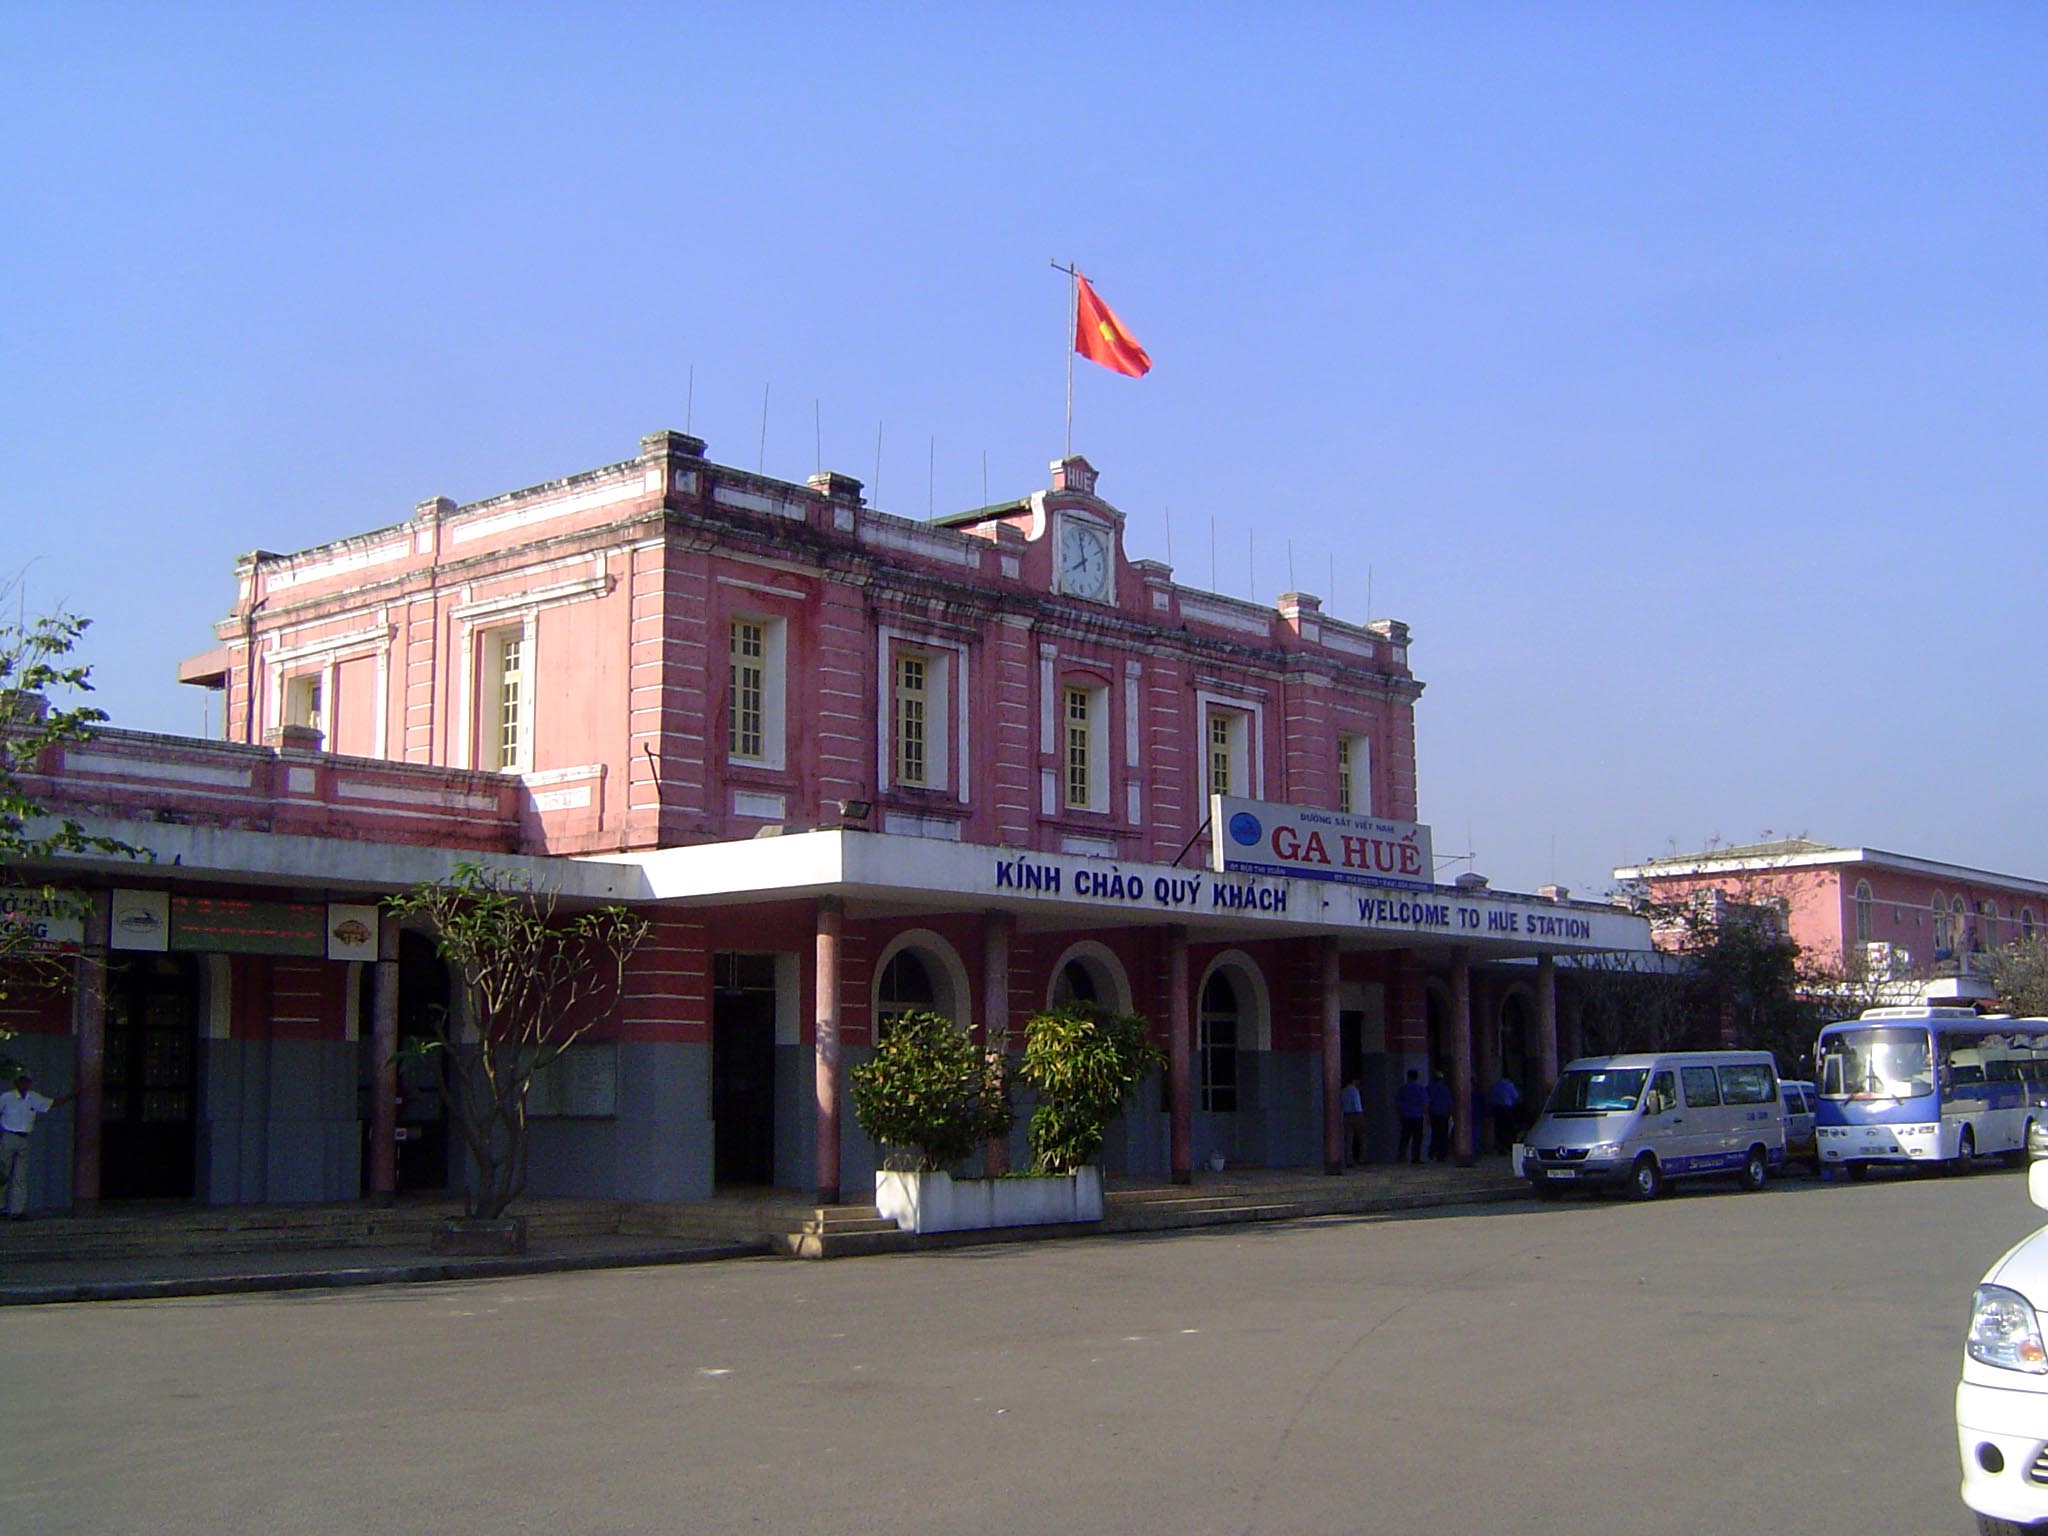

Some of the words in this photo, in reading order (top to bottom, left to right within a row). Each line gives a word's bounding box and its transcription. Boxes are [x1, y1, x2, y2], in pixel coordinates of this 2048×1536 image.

[1271, 825, 1331, 865] GA
[1341, 829, 1422, 875] HUẾ
[996, 856, 1061, 891] KÍNH
[1074, 866, 1144, 900] CHÀO
[1154, 875, 1201, 906] QUÝ
[1213, 877, 1287, 912] KHÁCH
[1359, 898, 1450, 926] WELCOME
[1457, 907, 1480, 929] TO
[1488, 911, 1518, 932] HUE
[1527, 914, 1590, 939] STATION
